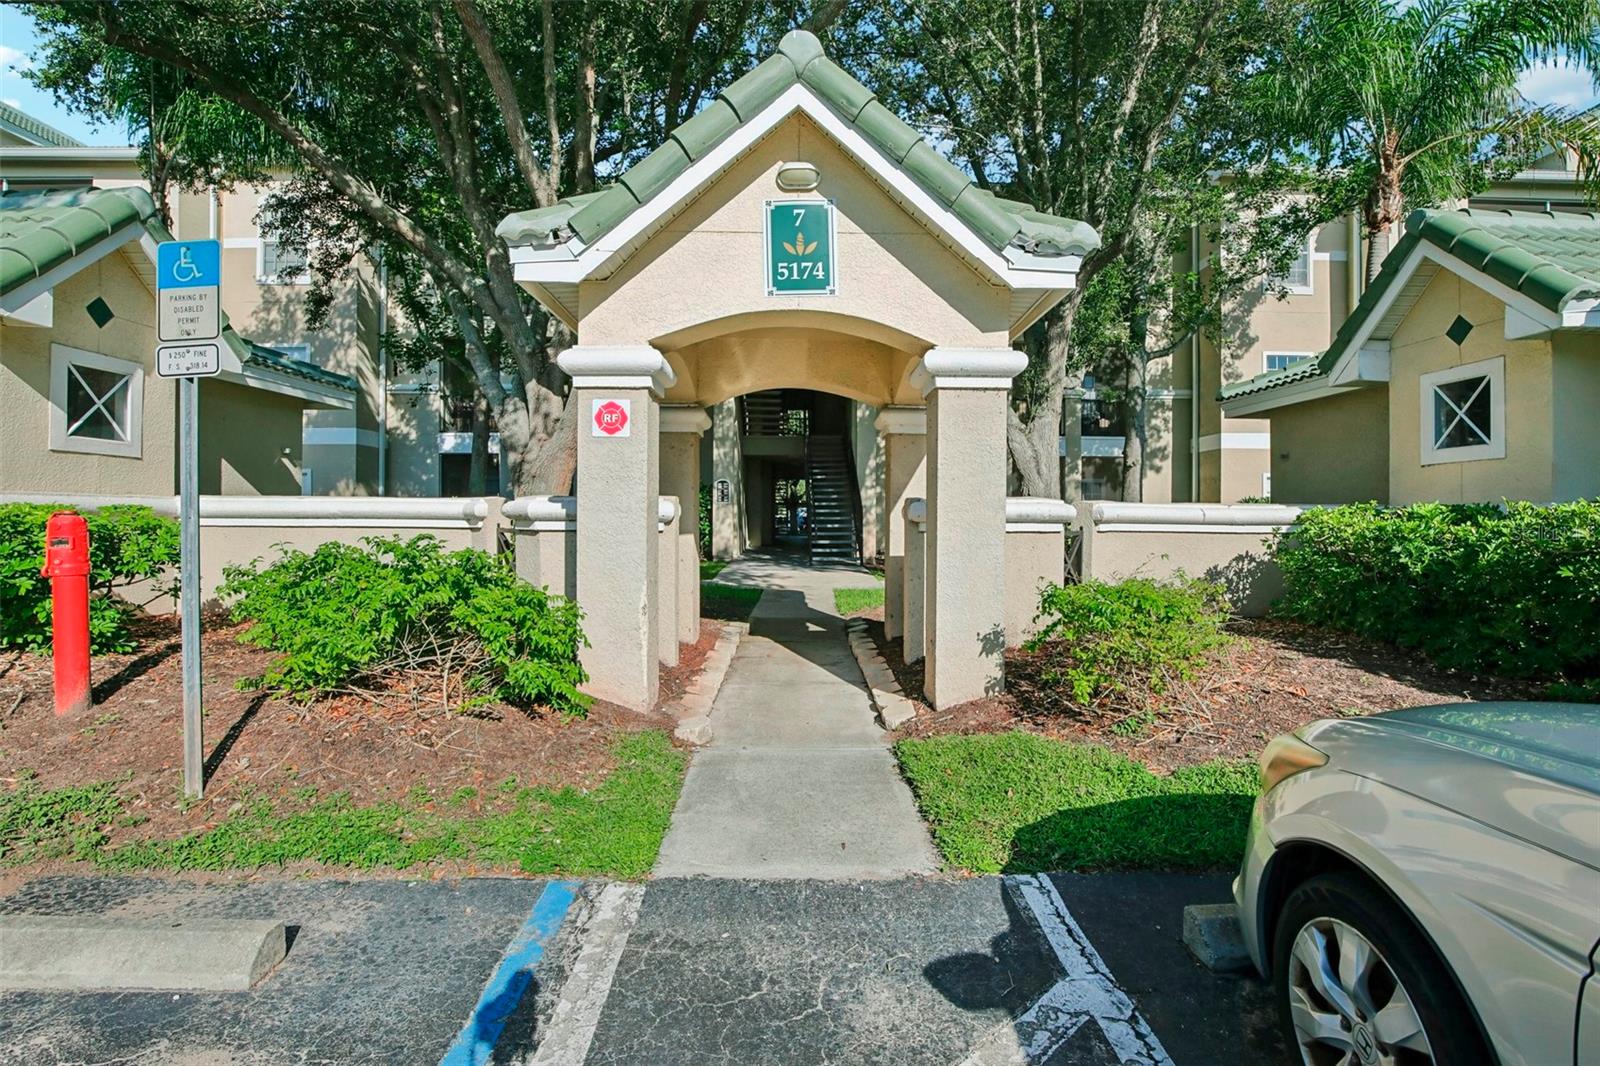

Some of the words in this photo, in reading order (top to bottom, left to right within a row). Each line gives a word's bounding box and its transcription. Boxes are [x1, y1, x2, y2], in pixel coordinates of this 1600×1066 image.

[792, 208, 806, 227] 7
[776, 261, 825, 281] 5174
[169, 293, 196, 302] PARKING
[199, 293, 208, 301] BY
[173, 305, 204, 314] DISABLED
[177, 317, 200, 325] PERMIT
[193, 349, 207, 358] FINE
[604, 413, 619, 423] RF
